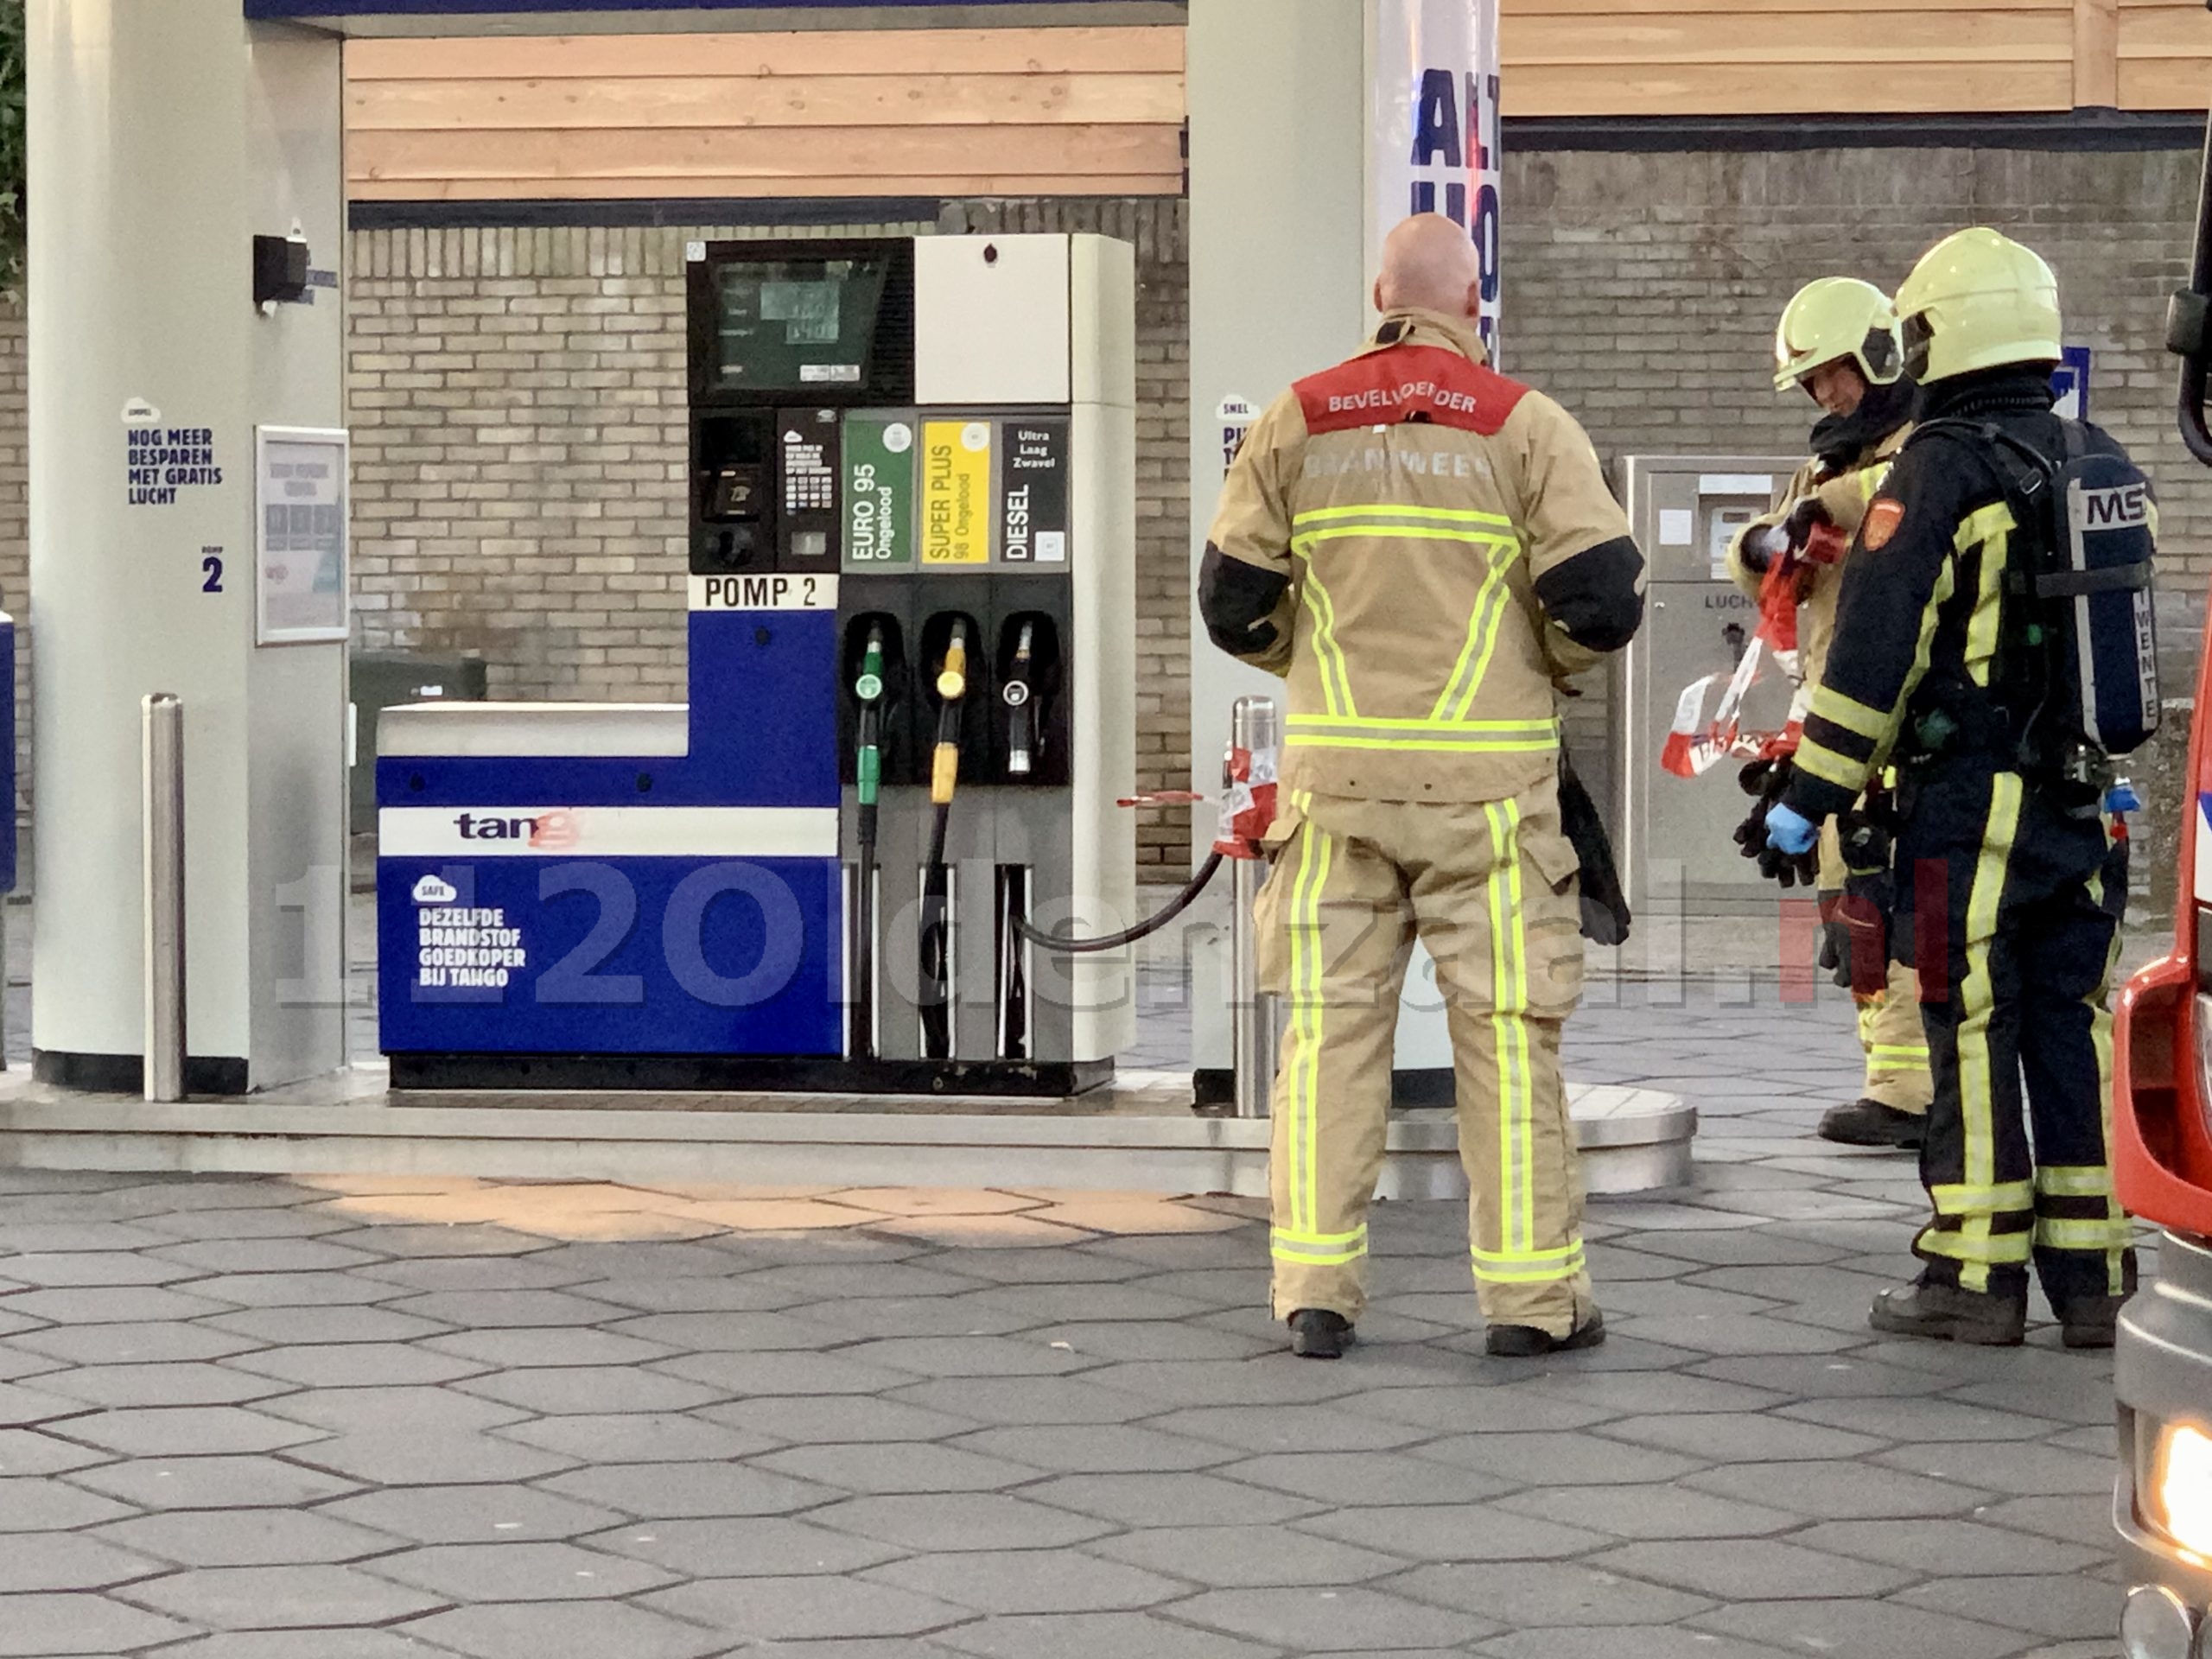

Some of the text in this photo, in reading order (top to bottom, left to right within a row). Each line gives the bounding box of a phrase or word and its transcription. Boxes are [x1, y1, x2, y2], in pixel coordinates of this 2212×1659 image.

[1224, 404, 1249, 414] SNEL
[128, 429, 212, 446] NOG MEER
[1018, 430, 1050, 442] Ultra
[128, 448, 212, 466] BESPAREN
[1020, 444, 1048, 457] Laag
[1013, 457, 1055, 468] Zwavel
[129, 467, 222, 485] MET GRATIS
[129, 487, 176, 505] LUCHT
[930, 445, 953, 560] SUPER PLUS
[955, 474, 973, 537] Ongelood
[852, 463, 875, 560] EURO 95
[875, 486, 895, 560] Ongelood
[1006, 484, 1029, 559] DIESEL
[203, 556, 223, 593] 2
[705, 577, 817, 607] POMP 2
[1705, 594, 1753, 610] LUCH
[419, 908, 504, 927] DEZELFDE
[419, 928, 521, 947] BRANDSTOF
[419, 948, 526, 967] GOEDKOPER
[419, 968, 509, 987] BIJ TANGO
